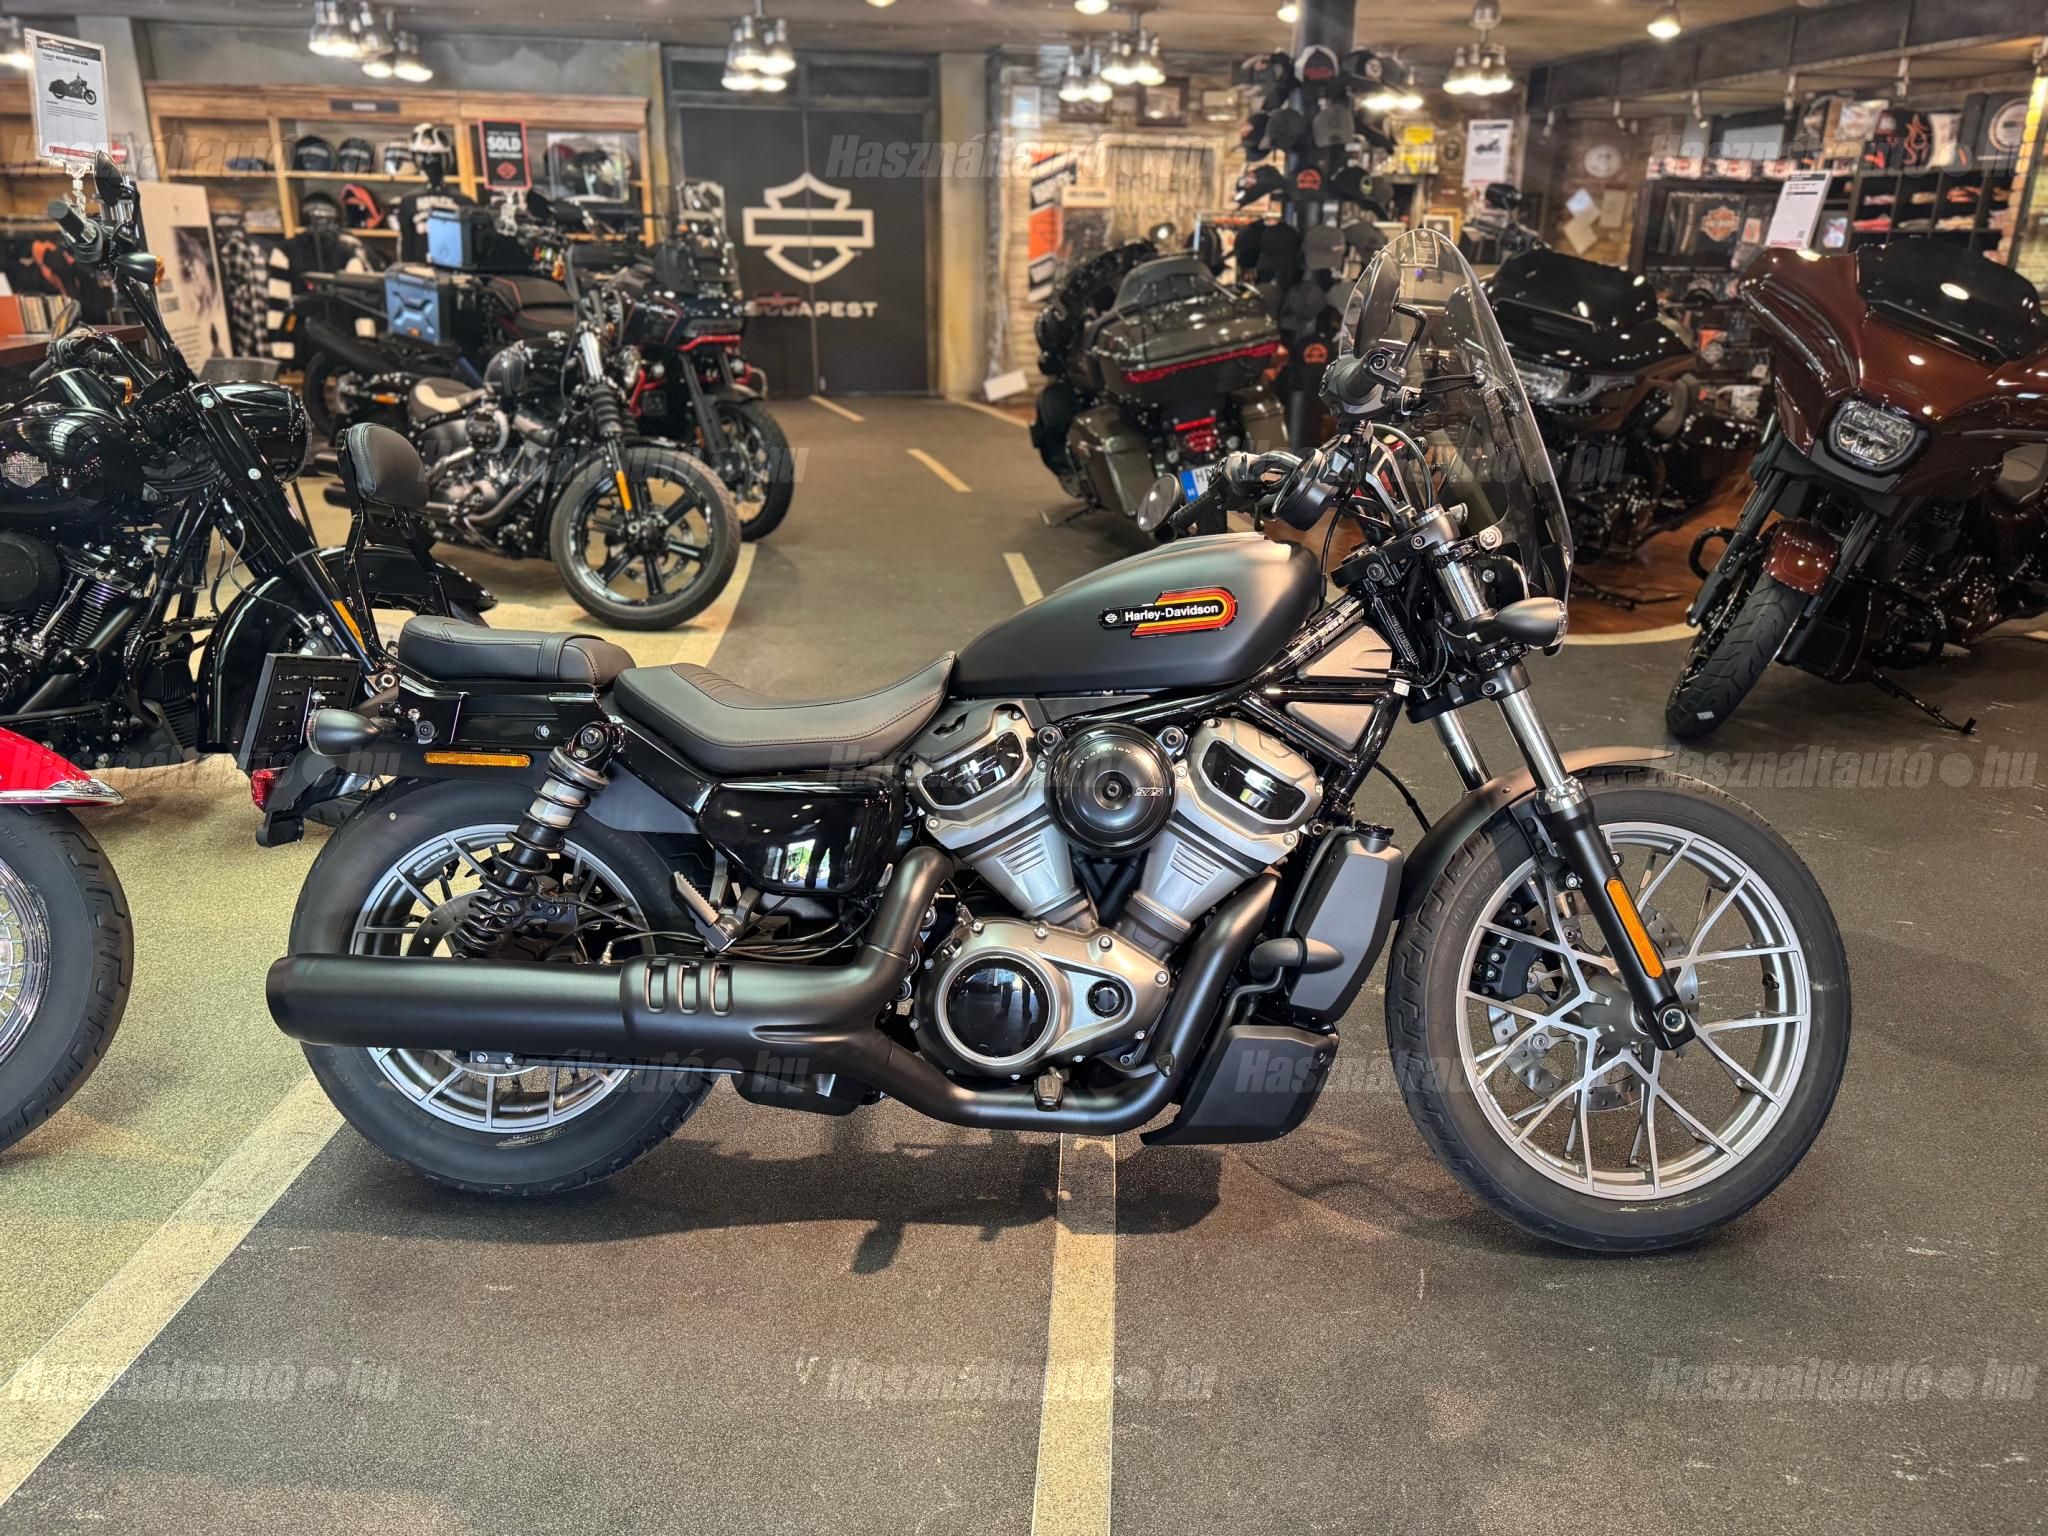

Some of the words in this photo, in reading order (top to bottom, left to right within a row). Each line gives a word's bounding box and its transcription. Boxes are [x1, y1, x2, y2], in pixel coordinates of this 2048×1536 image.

[487, 136, 521, 151] SOLD
[1125, 603, 1219, 622] Harley-Davidson
[1076, 745, 1131, 769] REVOLUTION
